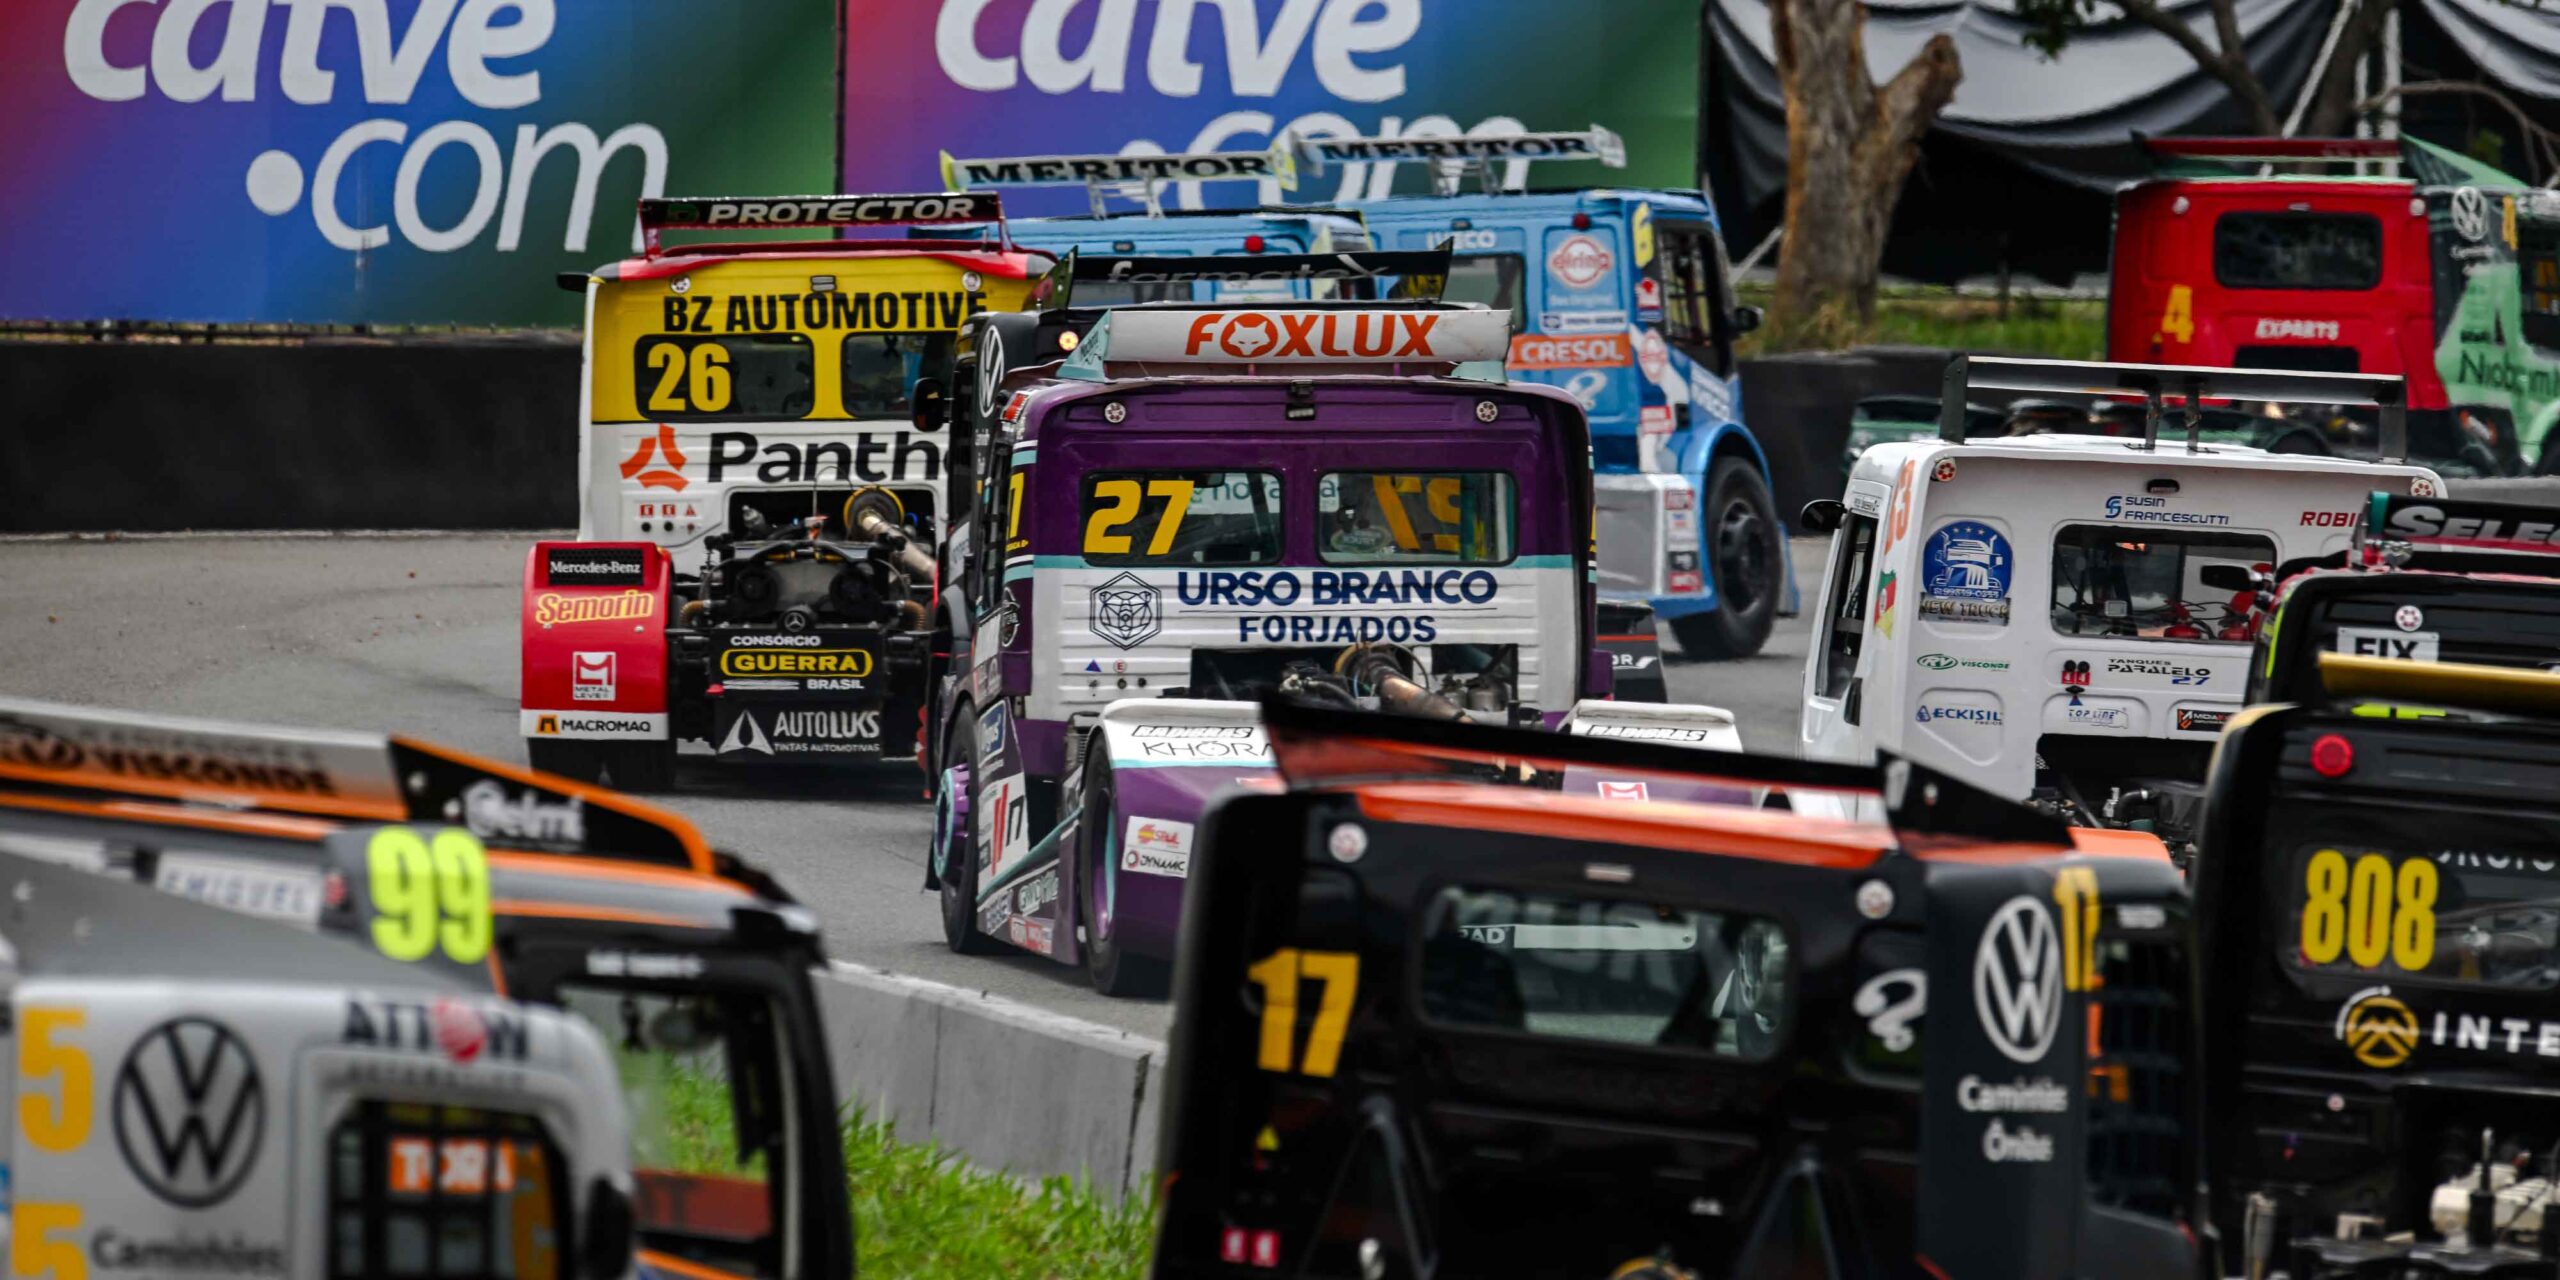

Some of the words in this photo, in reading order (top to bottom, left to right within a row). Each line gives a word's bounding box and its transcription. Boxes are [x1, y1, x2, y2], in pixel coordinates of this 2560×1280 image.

[1318, 137, 1590, 160] MERITOR
[964, 156, 1269, 184] MERITOR
[707, 198, 975, 224] PROTECTOR
[663, 295, 714, 332] BZ
[2162, 284, 2195, 344] 4
[1521, 338, 1625, 363] CRESOL
[647, 342, 731, 412] 26
[708, 431, 949, 483] Panth
[2125, 496, 2166, 508] SUSIN
[1083, 479, 1196, 556] 27
[2124, 510, 2229, 526] FRANCESCUTTI
[549, 560, 642, 575] Mercedes-Benz
[1177, 571, 1302, 607] URSO
[1312, 569, 1498, 605] BRANCO
[536, 589, 654, 624] Semorin
[1239, 615, 1438, 643] FORJADOS
[734, 654, 859, 672] GUERRA
[2108, 664, 2212, 676] PARALELO
[807, 679, 865, 690] BRASIL
[2171, 676, 2211, 686] 27
[561, 719, 652, 732] MACROMAQ
[773, 710, 881, 739] AUTOLUKS
[1932, 707, 2002, 722] ECKISIL
[774, 742, 808, 752] TINTAS
[810, 743, 881, 753] AUTOMOTIVAS
[366, 824, 495, 965] 99
[2300, 848, 2440, 972] 808
[1247, 946, 1361, 1078] 17
[19, 1005, 93, 1154] 5
